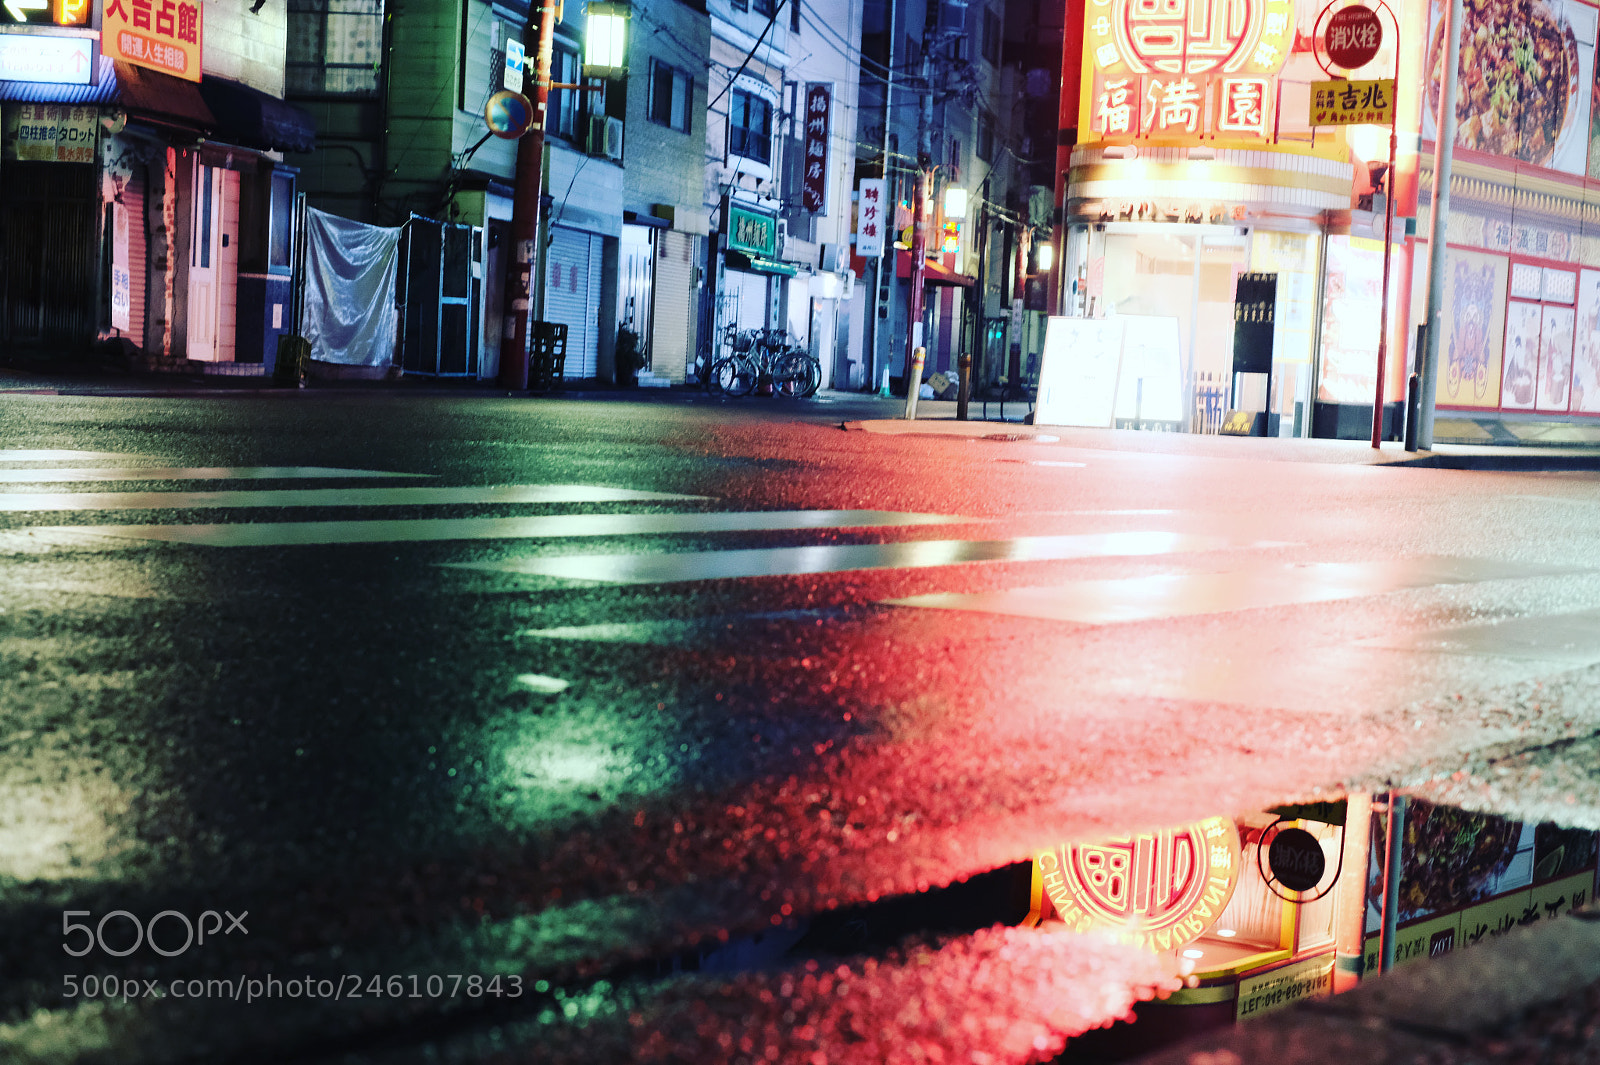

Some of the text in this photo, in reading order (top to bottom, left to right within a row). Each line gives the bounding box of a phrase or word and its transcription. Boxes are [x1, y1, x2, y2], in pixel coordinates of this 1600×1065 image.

[1330, 23, 1378, 50] 消火栓
[121, 33, 185, 71] 開運人生相談
[1098, 77, 1268, 135] 福満園
[1339, 83, 1387, 110] 吉兆
[20, 125, 57, 141] 四柱推命
[58, 126, 95, 143] タロット
